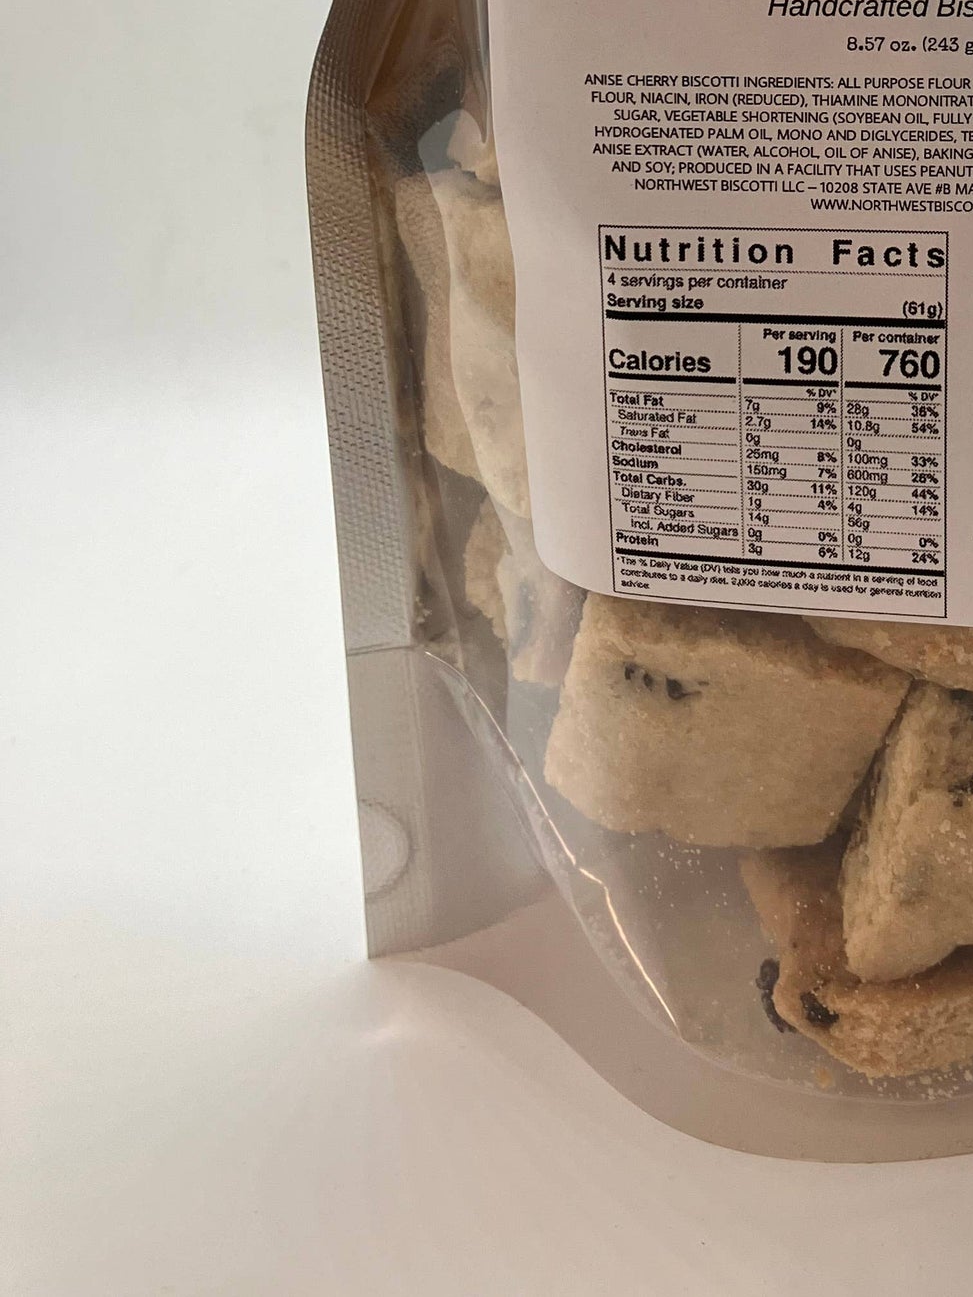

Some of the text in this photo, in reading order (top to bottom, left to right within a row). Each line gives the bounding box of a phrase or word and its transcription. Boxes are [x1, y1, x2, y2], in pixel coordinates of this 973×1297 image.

[846, 36, 886, 52] 8.57
[889, 40, 918, 53] oz.
[922, 35, 960, 53] (243
[584, 73, 624, 87] ANISE
[626, 74, 679, 88] CHERRY
[681, 75, 740, 88] BISCOTTI
[743, 75, 835, 90] INGREDIENTS:
[836, 76, 862, 90] ALL
[863, 76, 926, 92] PURPOSE
[927, 77, 972, 93] FLOUR
[590, 90, 638, 106] FLOUR,
[640, 91, 692, 107] NIACIN,
[694, 92, 729, 106] IRON
[731, 92, 809, 109] (REDUCED),
[811, 93, 881, 109] THIAMINE
[613, 108, 662, 124] SUGAR,
[663, 110, 739, 123] VEGETABLE
[741, 110, 830, 124] SHORTENING
[832, 110, 902, 127] (SOYBEAN
[904, 112, 930, 127] OIL,
[932, 112, 973, 127] FULLY
[594, 125, 705, 140] HYDROGENATED
[707, 127, 745, 141] PALM
[747, 127, 774, 143] OIL,
[776, 128, 823, 141] MONO
[825, 128, 857, 142] AND
[860, 129, 960, 144] DIGLYCERIDES,
[592, 142, 632, 156] ANISE
[634, 143, 694, 157] EXTRACT
[752, 145, 821, 160] ALCOHOL,
[824, 146, 848, 159] OIL
[849, 146, 870, 160] OF
[871, 147, 921, 162] ANISE),
[611, 160, 642, 173] AND
[644, 160, 676, 176] SOY;
[678, 161, 753, 175] PRODUCED
[756, 162, 771, 175] IN
[773, 162, 785, 176] A
[786, 162, 843, 177] FACILITY
[845, 163, 882, 177] THAT
[883, 164, 918, 182] USES
[634, 177, 719, 192] NORTHWEST
[720, 179, 778, 193] BISCOTTI
[781, 180, 806, 194] LLC
[819, 181, 859, 195] 10208
[862, 181, 903, 195] STATE
[904, 182, 933, 196] AVE
[934, 182, 952, 196] #B
[604, 234, 946, 269] Nutrition Facts
[606, 271, 789, 292] 4 servings per container
[607, 293, 944, 320] Serving size (61g)
[762, 327, 837, 345] Per serving
[852, 330, 941, 346] Per container
[608, 346, 941, 379] Calories 190 760
[610, 392, 870, 417] Total Fat 7g 28g
[618, 409, 880, 434] Saturated Fat 2.7g 10.8g
[651, 428, 862, 451] Fat 0g 0g
[611, 440, 888, 468] Cholesterol 100mg
[612, 456, 658, 469] Sodium
[613, 471, 877, 500] Total Carbs. 30g 120g
[621, 487, 862, 516] Dietary Fiber 1g 4g
[621, 502, 770, 525] Total Sugars 14g
[657, 522, 695, 534] Added
[697, 524, 739, 539] Sugars
[616, 532, 870, 562] Protein 3g 12g
